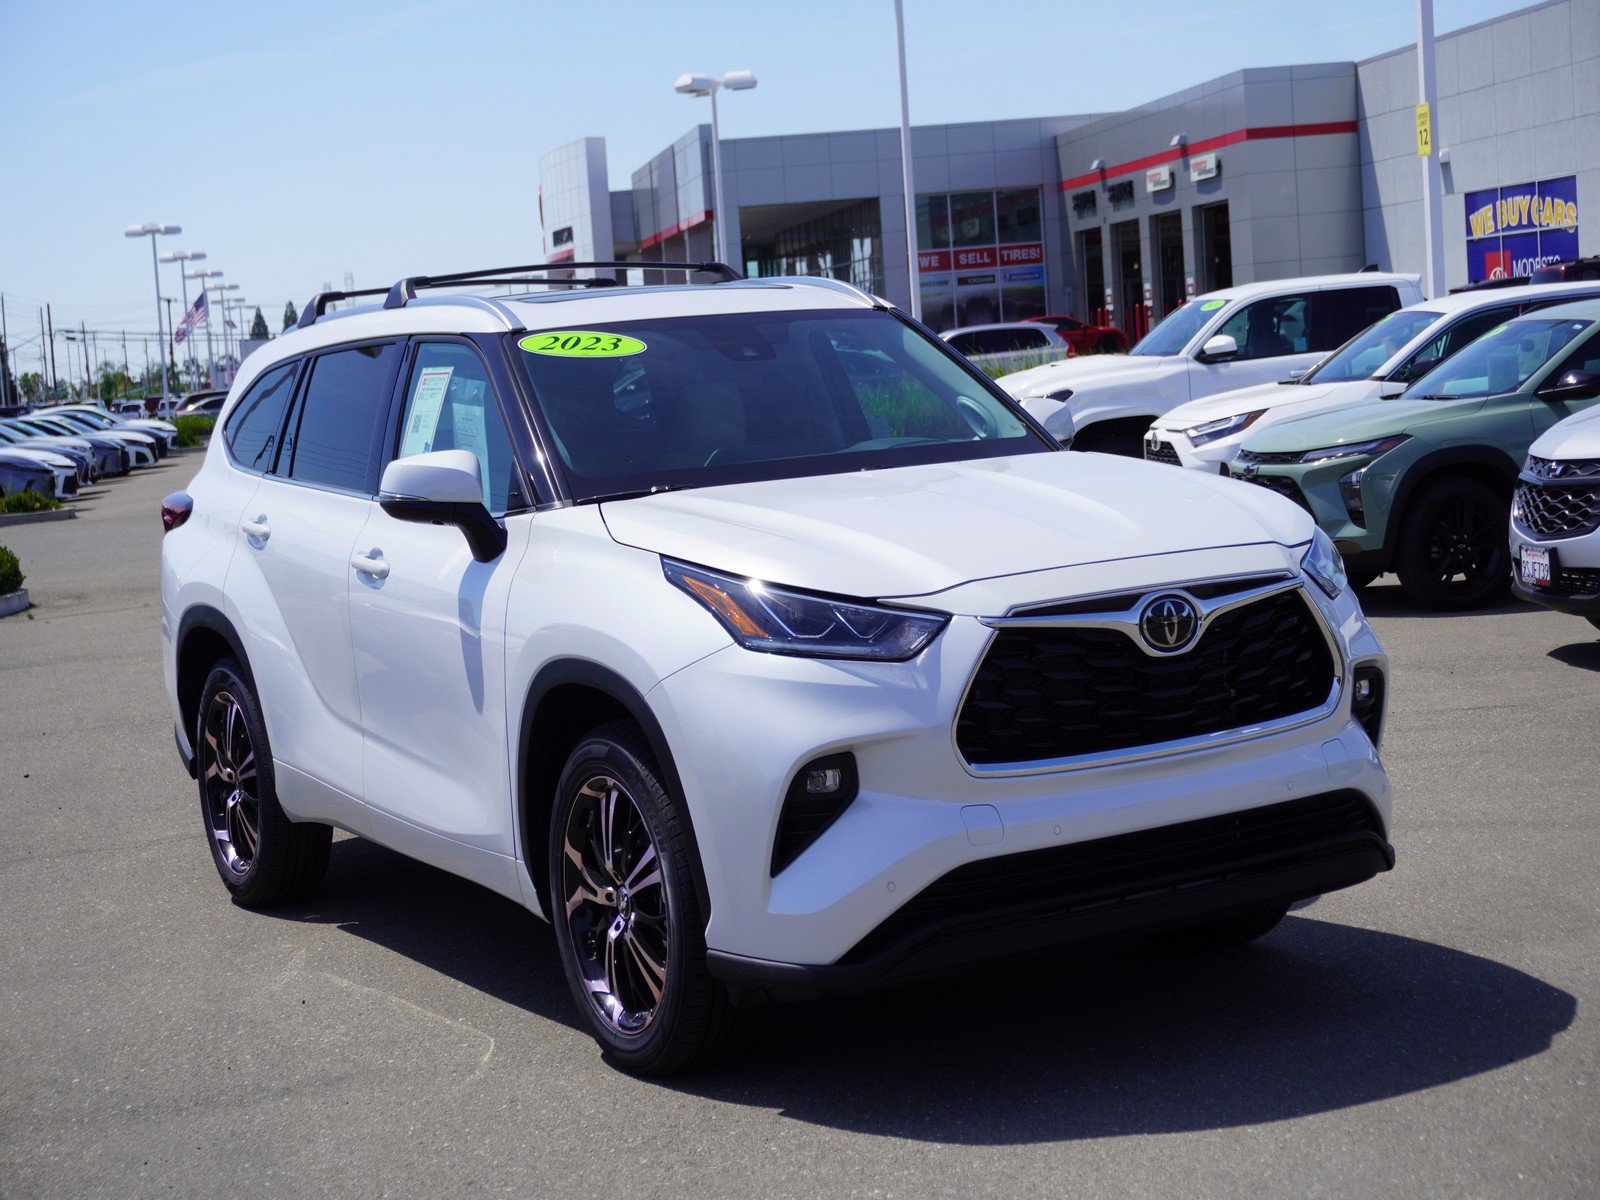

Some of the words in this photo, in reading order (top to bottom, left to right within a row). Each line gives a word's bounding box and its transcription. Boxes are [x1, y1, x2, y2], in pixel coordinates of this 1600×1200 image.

[1419, 128, 1429, 147] 12
[1469, 203, 1495, 239] WE
[1496, 195, 1531, 230] BUY
[1530, 195, 1577, 233] CARS
[919, 255, 940, 268] WE
[959, 252, 991, 265] SELL
[1001, 247, 1041, 262] TIRES!
[538, 336, 622, 351] 2023
